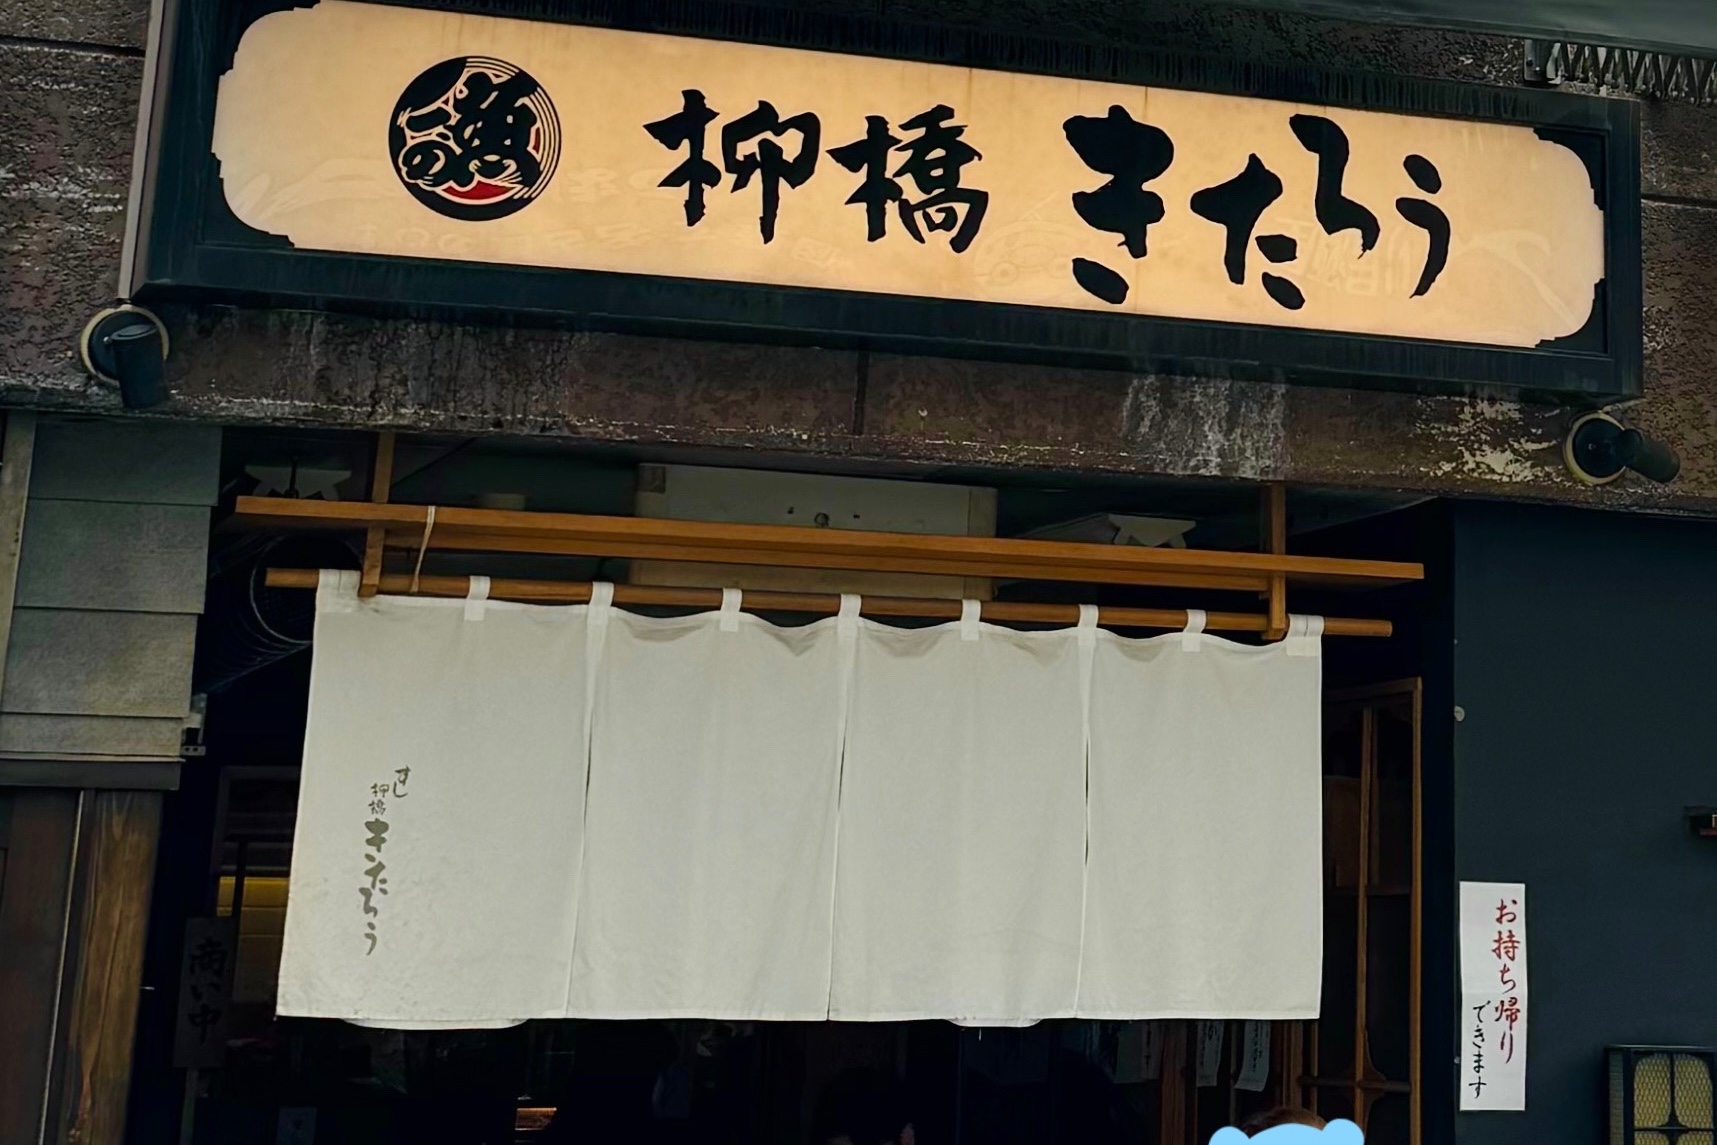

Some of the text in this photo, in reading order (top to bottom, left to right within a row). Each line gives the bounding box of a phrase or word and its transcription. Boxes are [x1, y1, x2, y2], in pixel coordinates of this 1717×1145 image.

[642, 88, 990, 254] 柳橋
[1469, 1000, 1491, 1099] できます
[1491, 898, 1521, 1064] お持ち帰り
